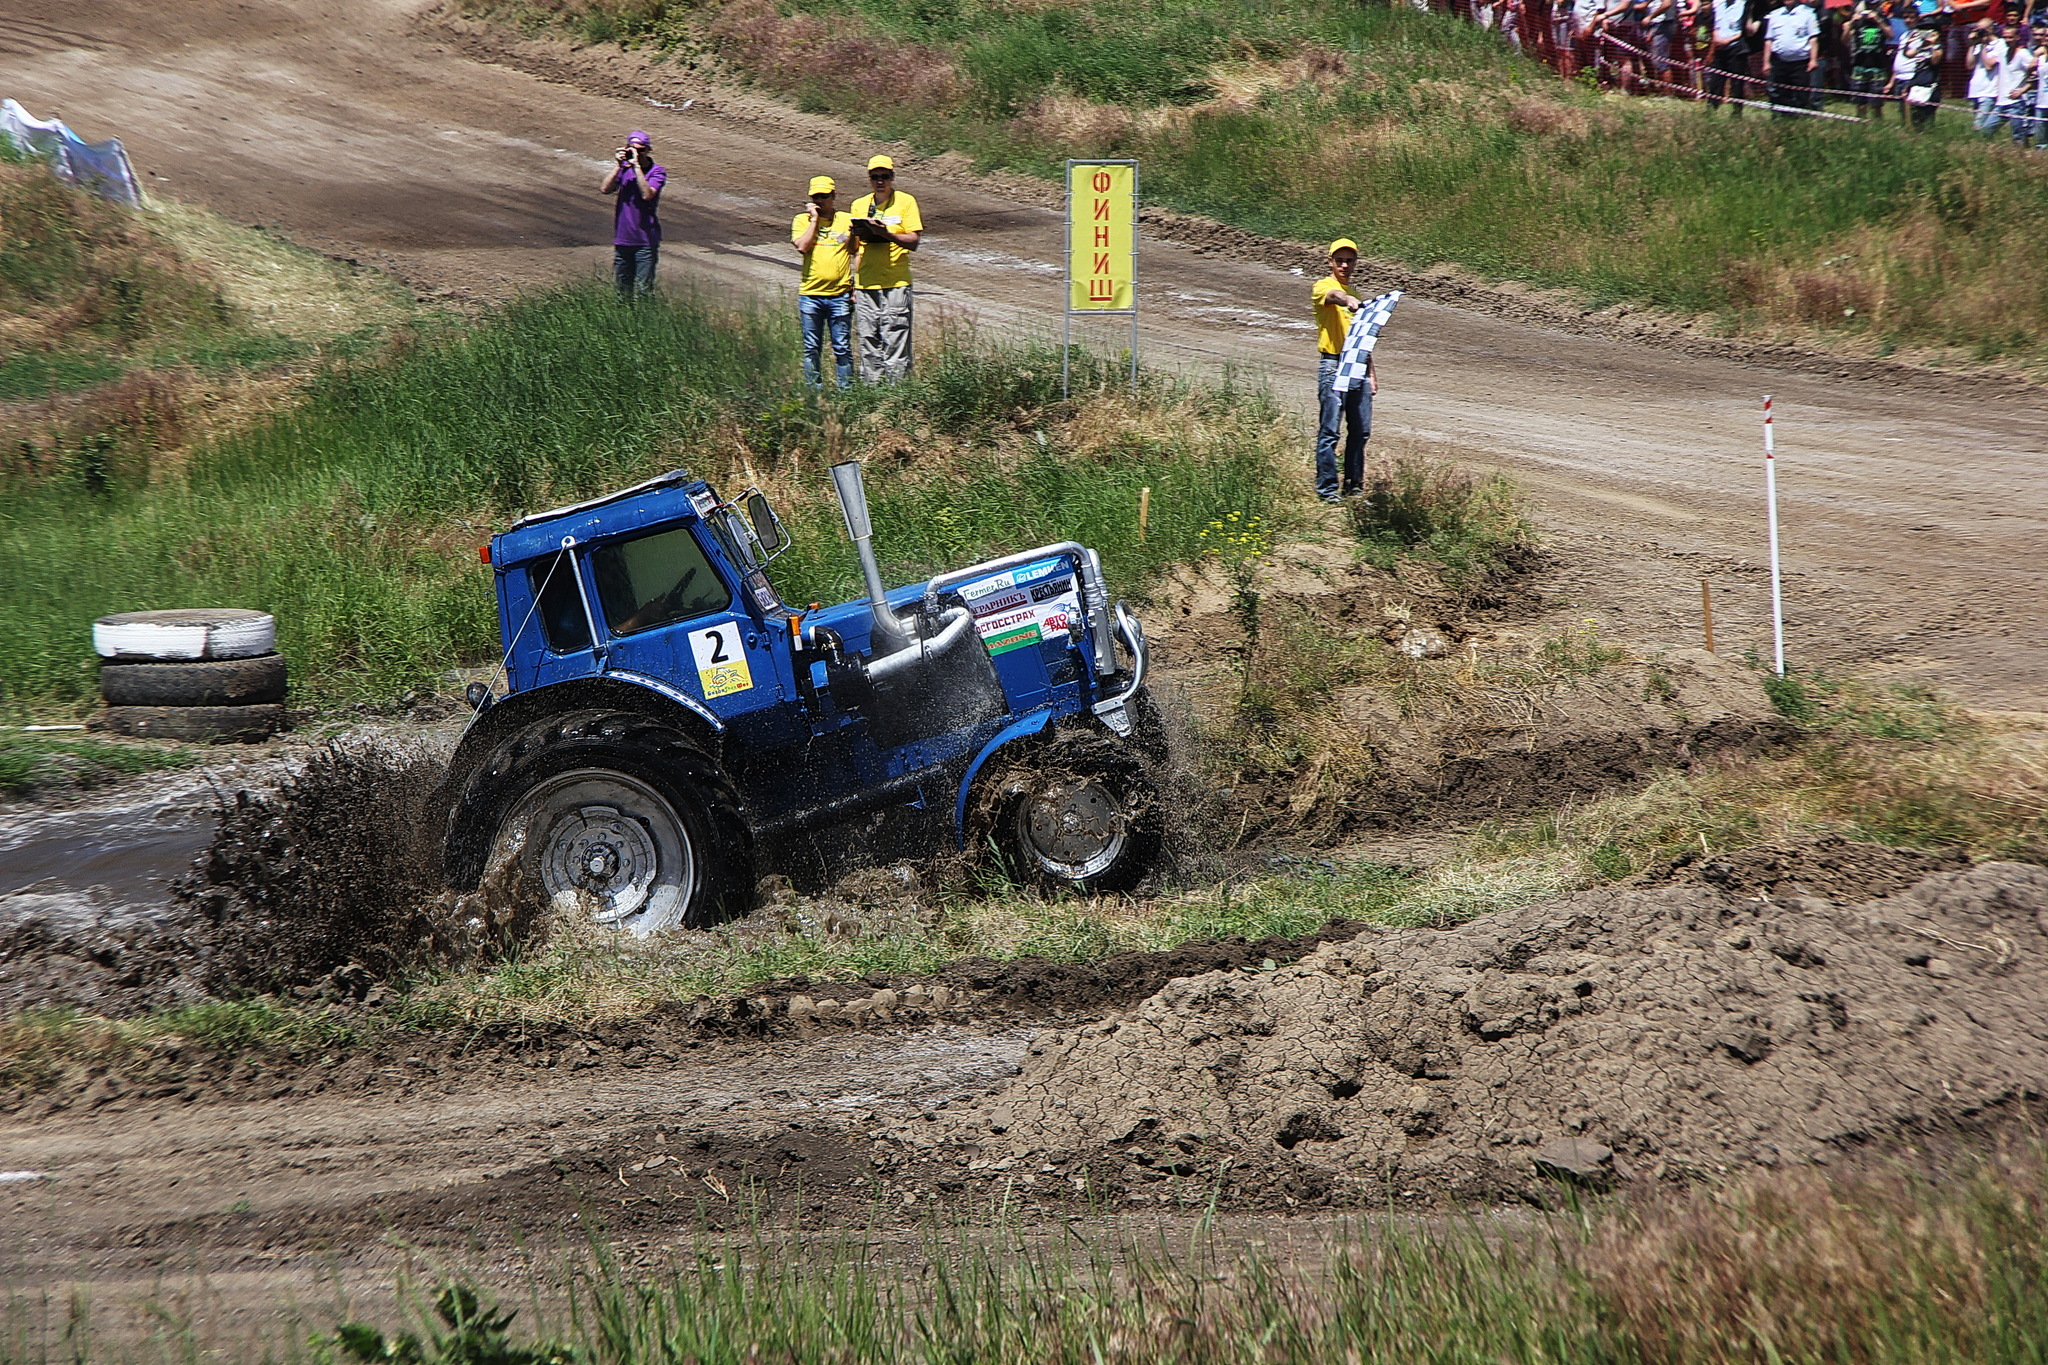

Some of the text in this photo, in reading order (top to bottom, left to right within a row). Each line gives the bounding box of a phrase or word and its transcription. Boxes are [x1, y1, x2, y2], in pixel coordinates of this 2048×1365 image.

[1090, 171, 1113, 301] ФИНИШ
[1025, 560, 1070, 580] LEMKEN
[962, 578, 1011, 599] Fermer.Ru
[975, 609, 1036, 635] ОСГОССТРАХ
[1043, 613, 1067, 628] АВТО
[1050, 621, 1068, 632] РАД
[704, 630, 729, 665] 2
[986, 629, 1038, 650] MAZONE
